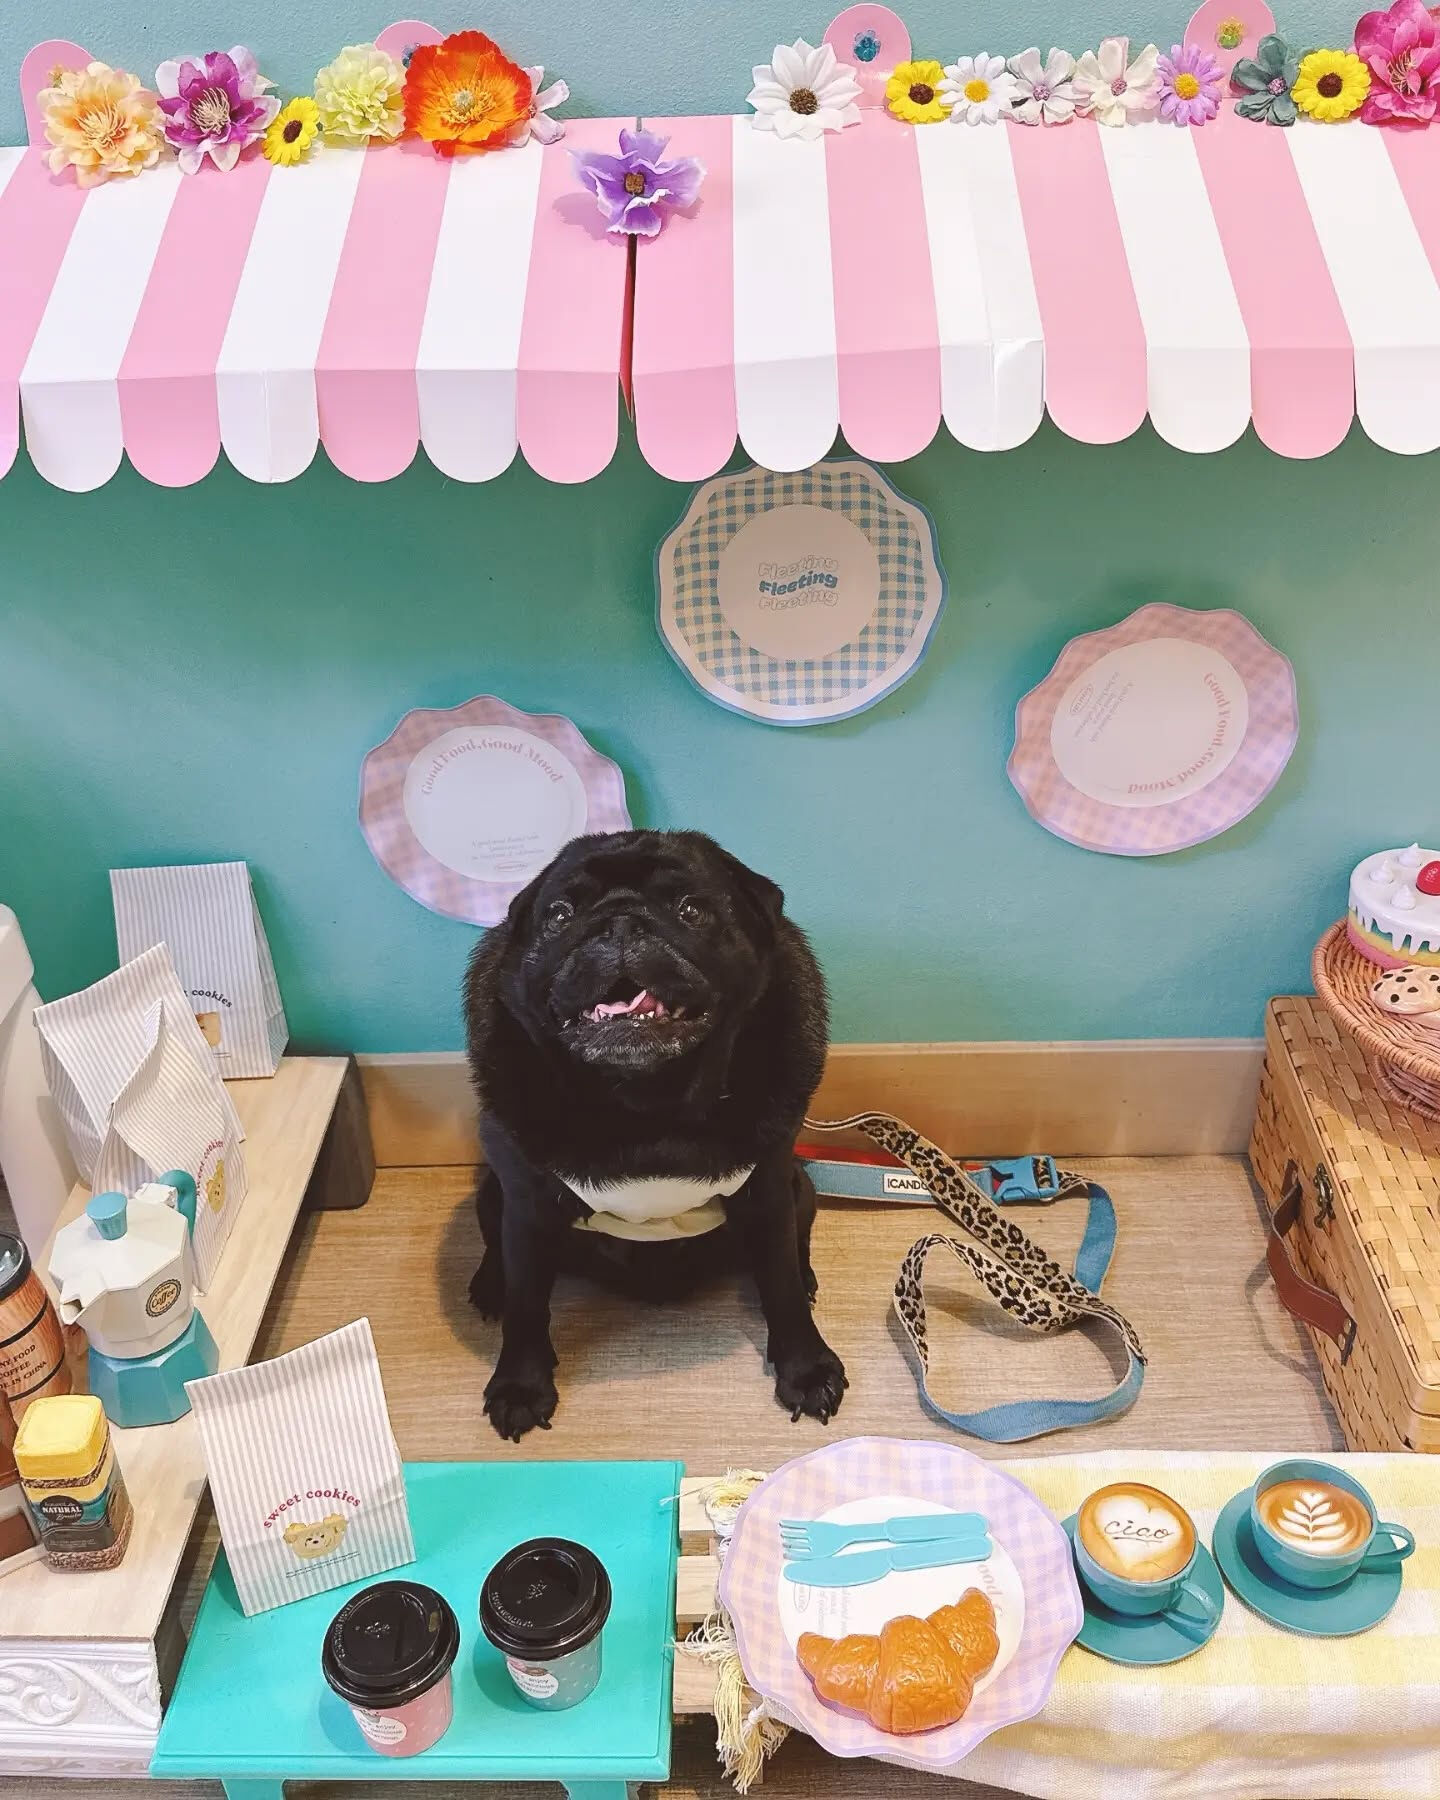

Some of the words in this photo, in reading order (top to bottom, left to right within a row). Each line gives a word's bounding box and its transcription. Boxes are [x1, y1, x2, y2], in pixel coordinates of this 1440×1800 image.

[758, 555, 839, 579] Fleeting
[759, 570, 838, 596] Fleeting
[758, 588, 839, 611] Fleeting
[191, 989, 233, 1008] cookies
[13, 1344, 36, 1362] FOOD
[23, 1360, 47, 1379] CHINA
[263, 1493, 302, 1528] sweet
[306, 1488, 361, 1507] cookies
